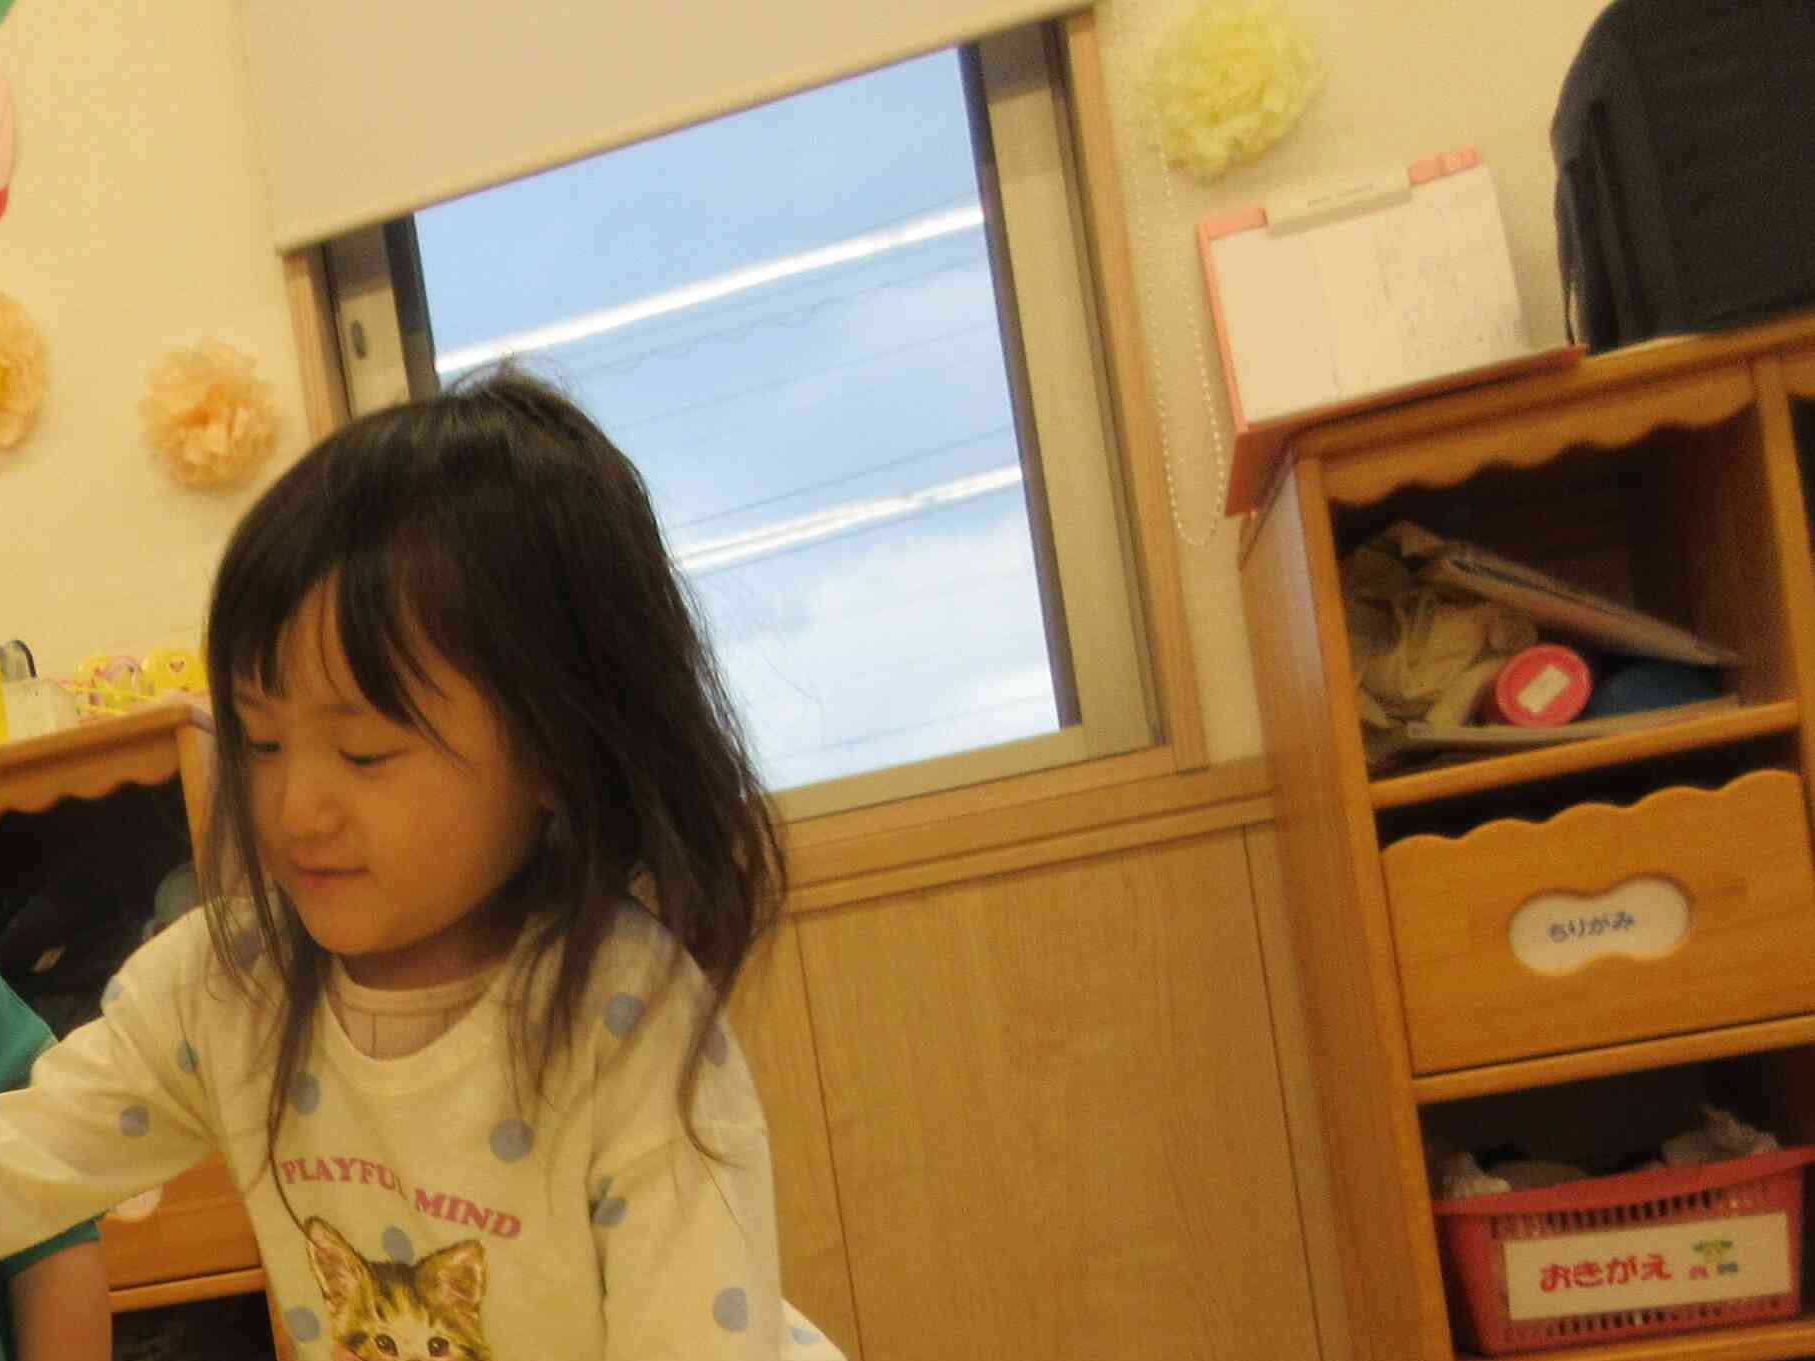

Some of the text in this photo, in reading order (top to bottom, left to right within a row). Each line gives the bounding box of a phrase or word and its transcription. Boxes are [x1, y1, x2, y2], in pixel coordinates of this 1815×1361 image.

[281, 1157, 523, 1239] PLAYFU MIND
[1540, 1253, 1671, 1292] おきがえ
